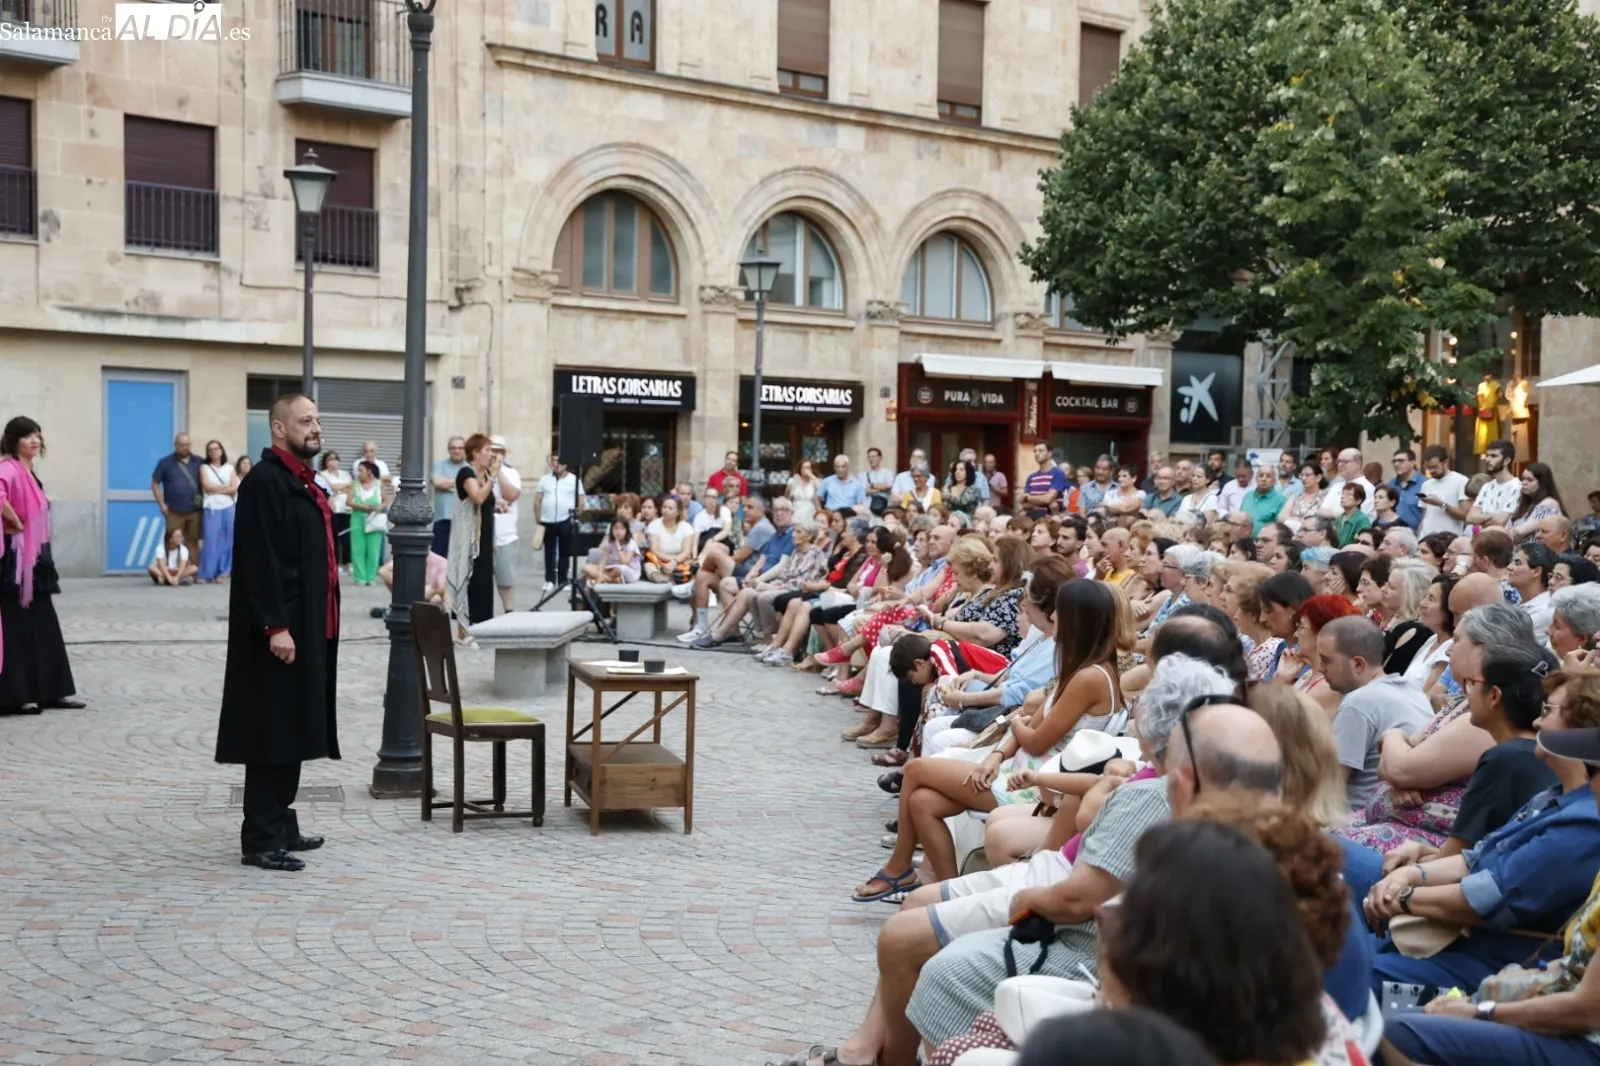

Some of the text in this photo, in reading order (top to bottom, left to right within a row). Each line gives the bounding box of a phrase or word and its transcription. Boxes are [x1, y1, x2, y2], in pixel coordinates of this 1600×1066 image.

[572, 375, 682, 398] LETRAS CORSARIAS
[760, 384, 852, 405] ETRAS CORSARIAS
[944, 390, 970, 402] PURA
[981, 393, 1004, 404] VIDA
[1056, 396, 1100, 408] COCKTAIL
[1101, 398, 1119, 409] BAR
